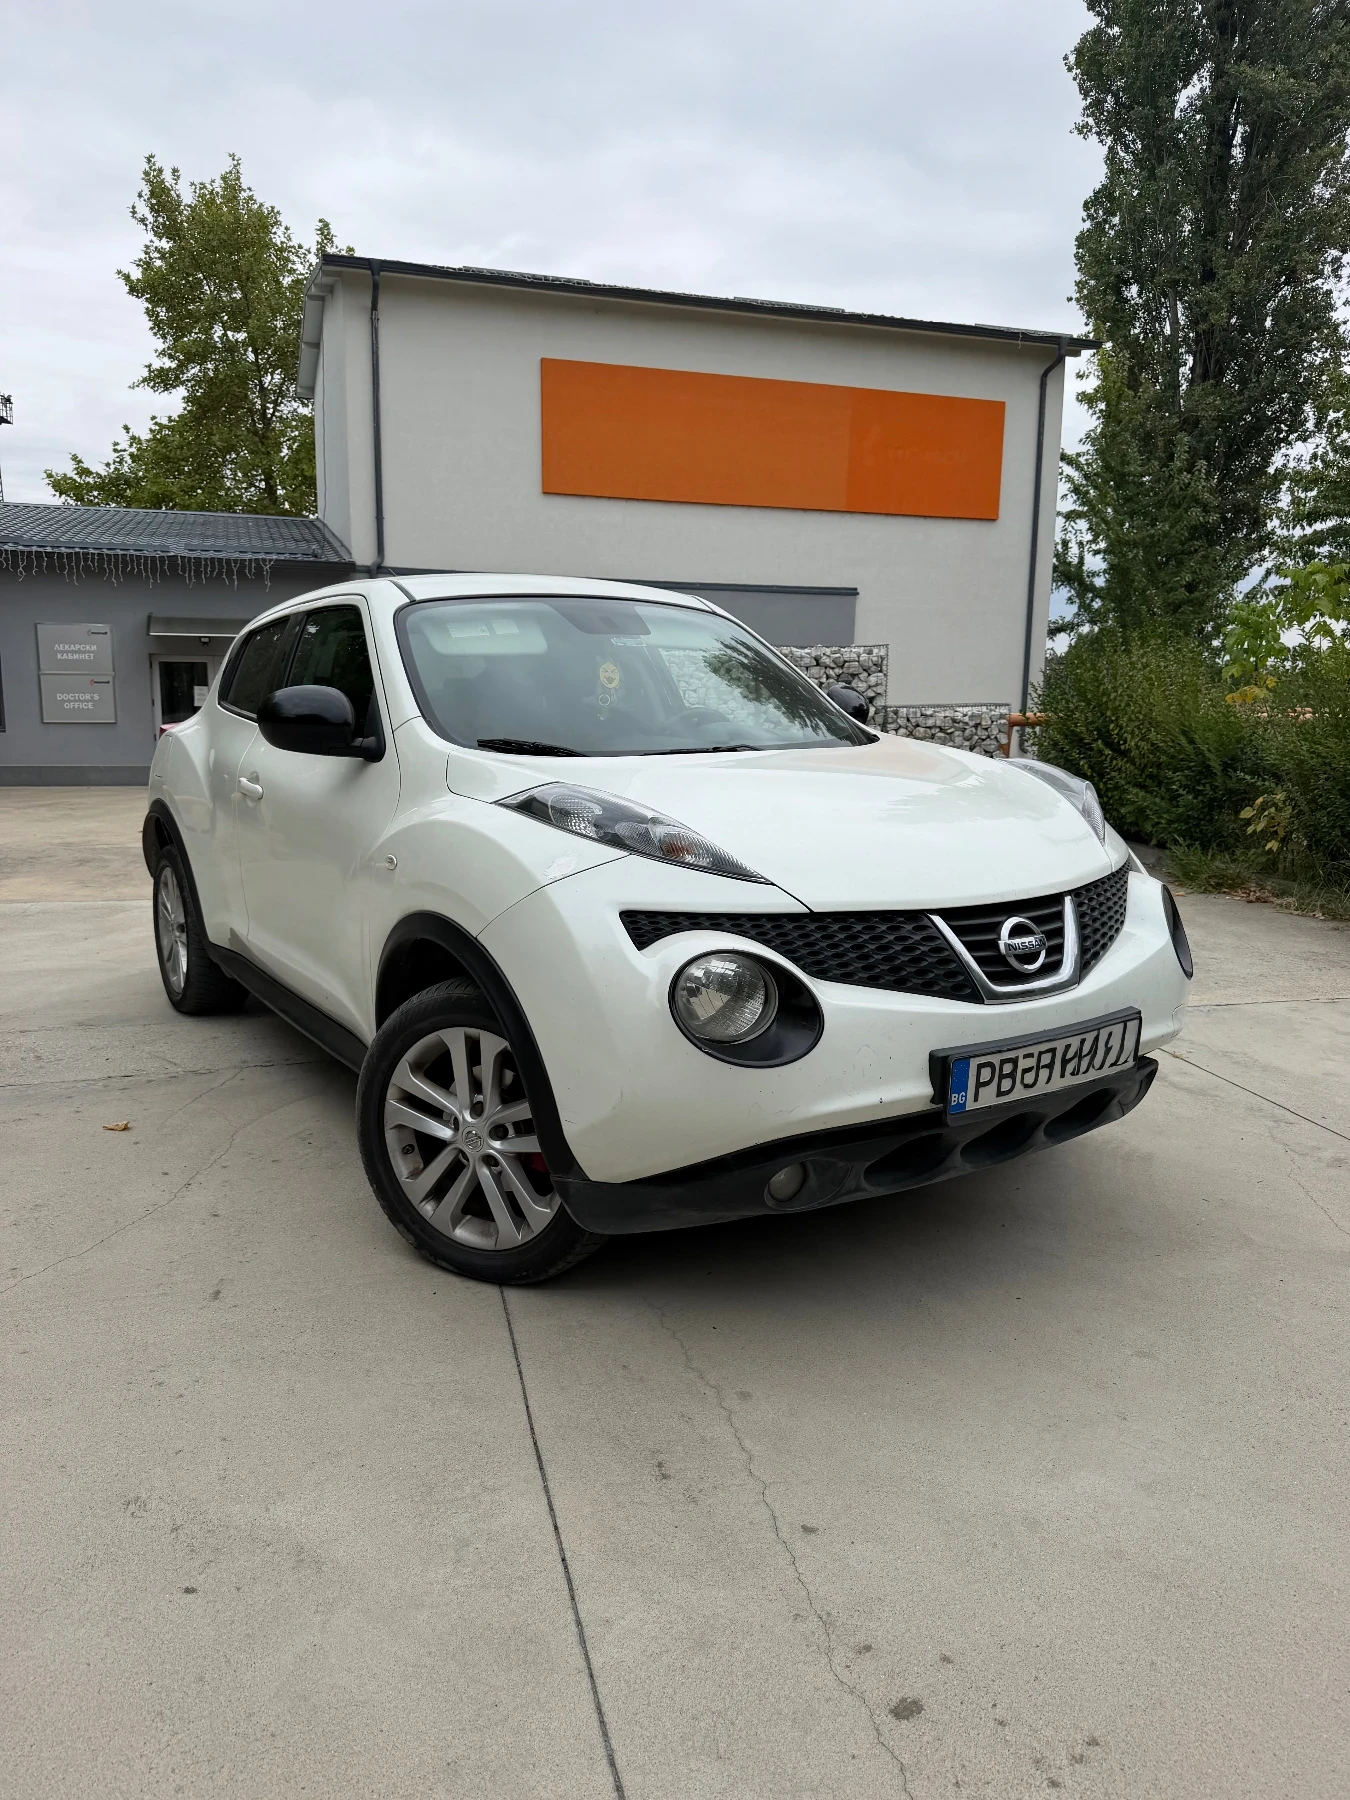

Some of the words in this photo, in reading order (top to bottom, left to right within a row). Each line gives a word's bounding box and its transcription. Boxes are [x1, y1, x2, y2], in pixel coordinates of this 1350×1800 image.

[54, 643, 97, 651] ЛЕКАРСКИ
[1007, 938, 1047, 952] NISSAN
[950, 1092, 966, 1106] BG
